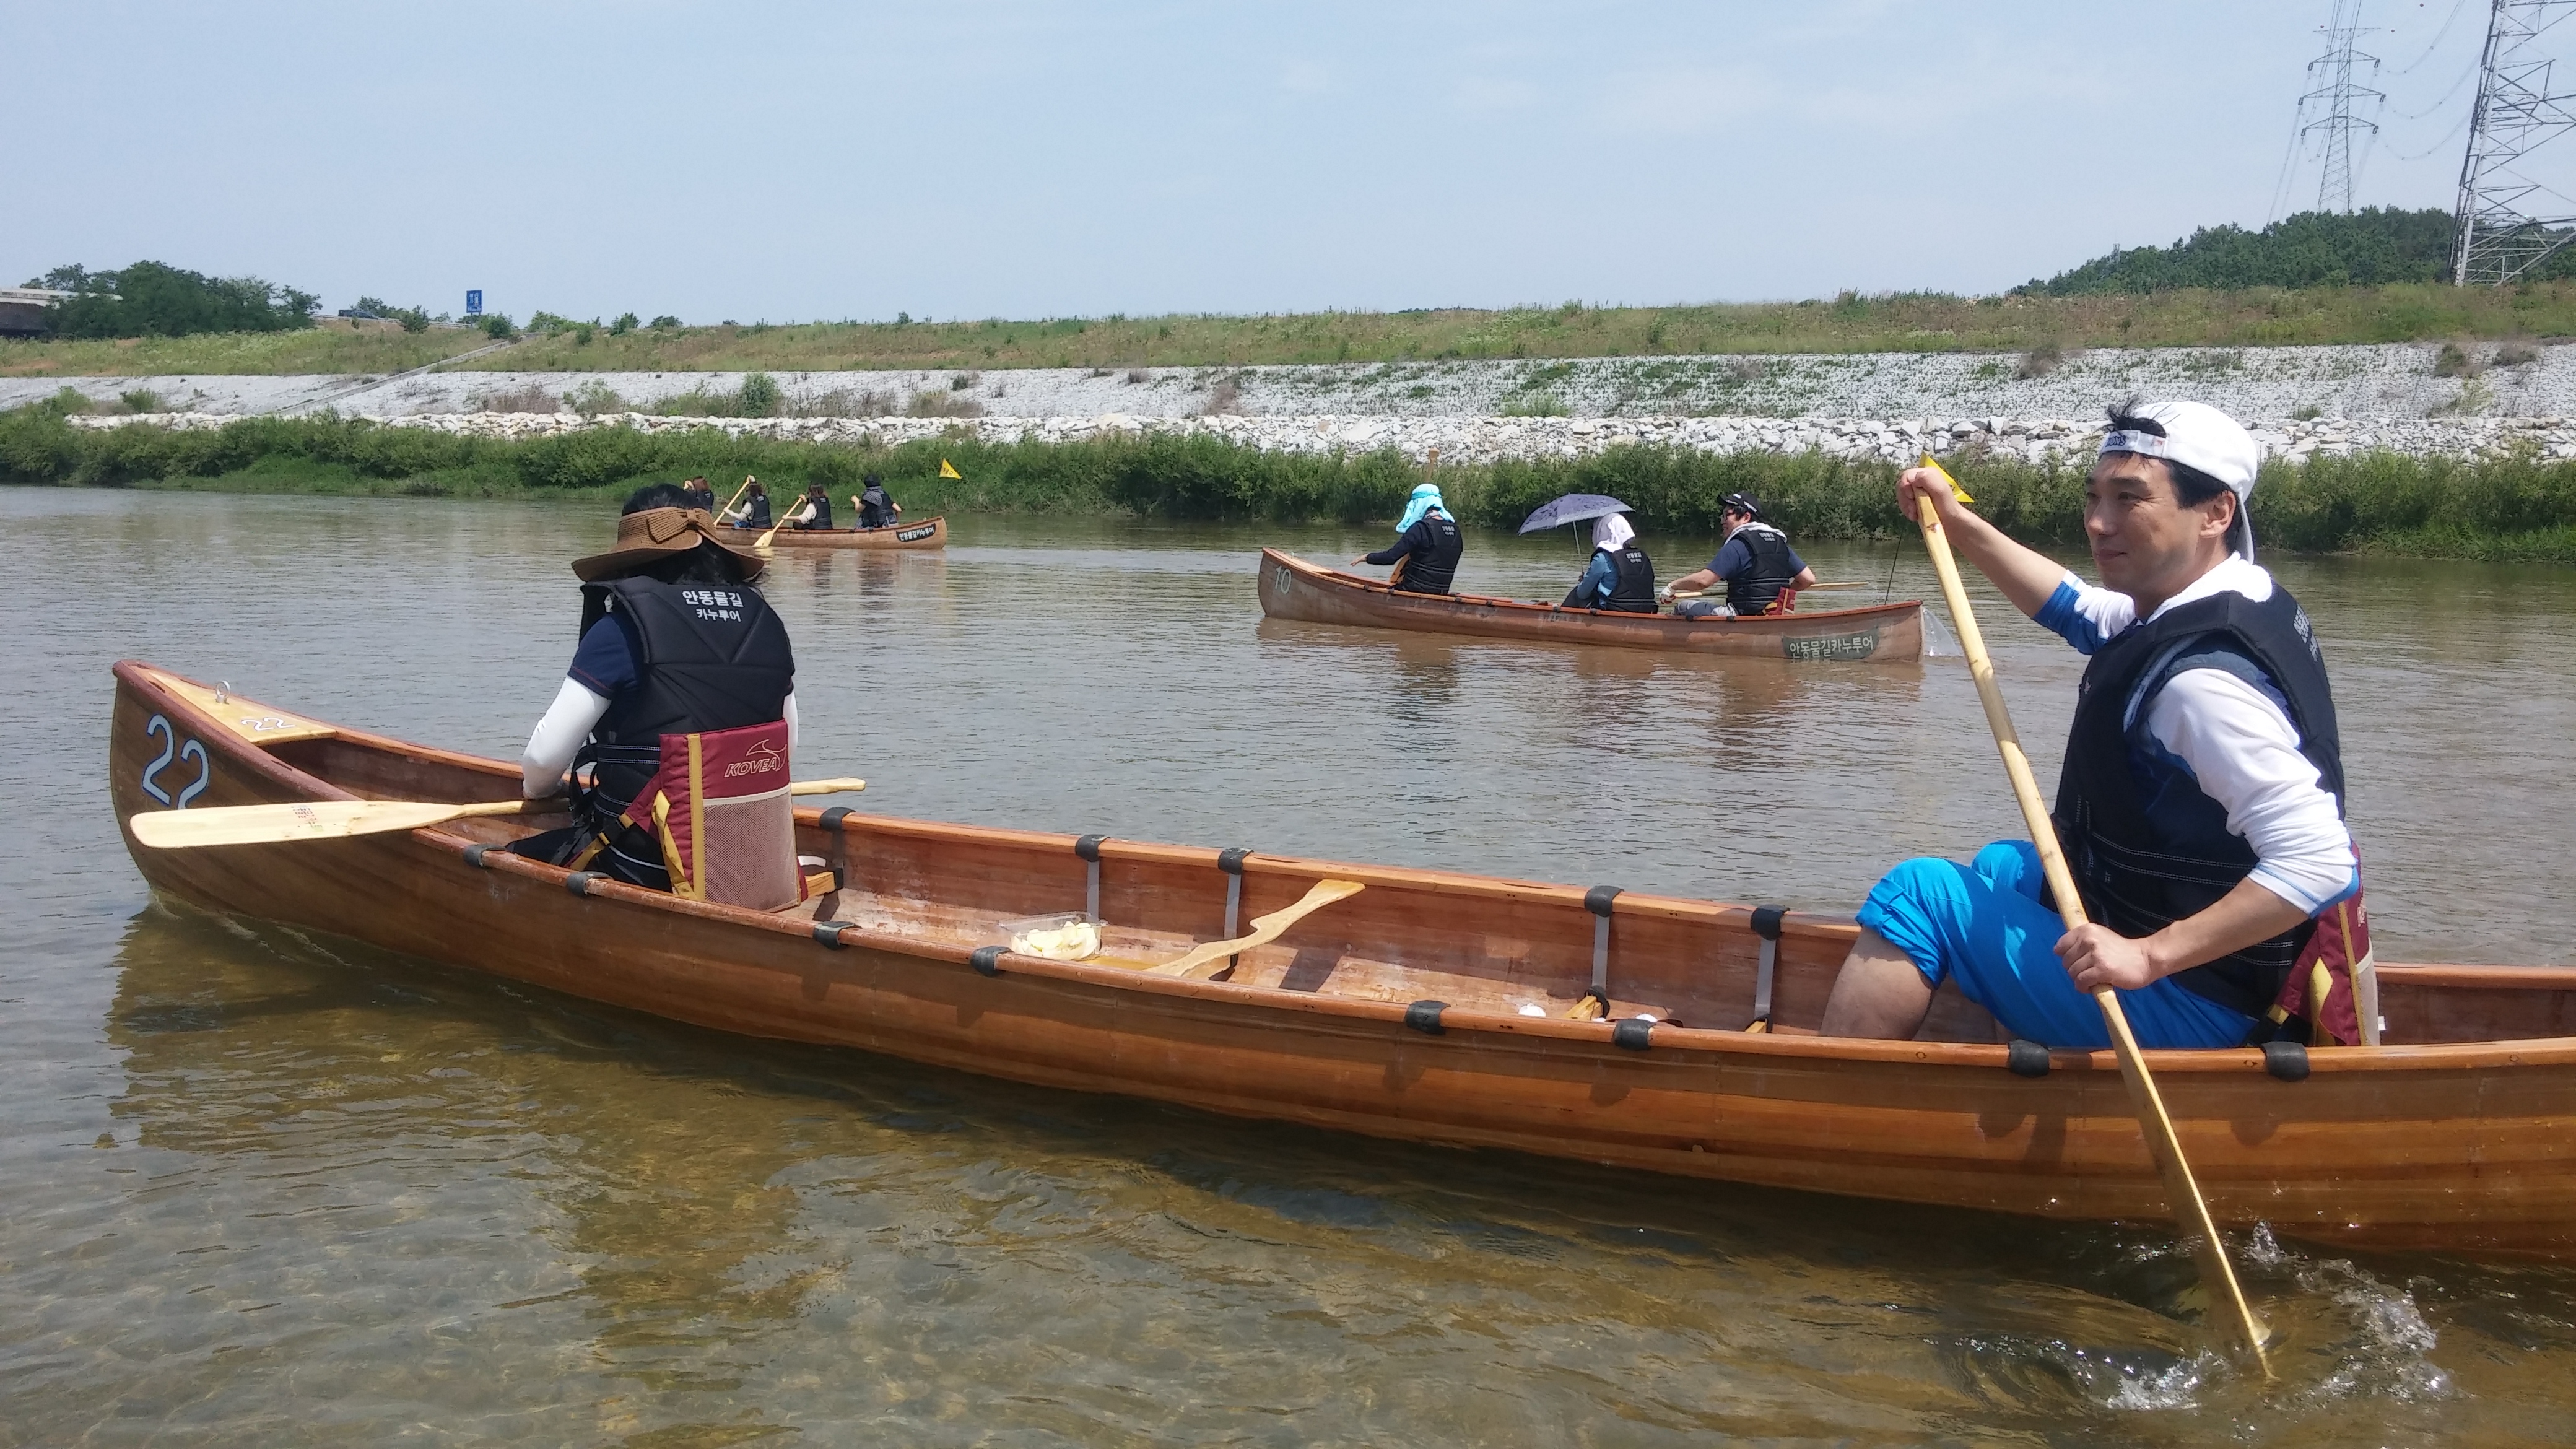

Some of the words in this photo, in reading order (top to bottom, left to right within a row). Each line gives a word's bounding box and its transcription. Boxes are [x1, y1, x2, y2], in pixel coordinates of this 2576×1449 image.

[1275, 564, 1292, 594] 10
[682, 590, 744, 607] 안동물길
[695, 608, 741, 622] 카누투어
[1789, 635, 1874, 659] 안동물길카누투어
[241, 716, 297, 731] 22
[142, 714, 211, 811] 22
[724, 757, 777, 778] KOVEA
